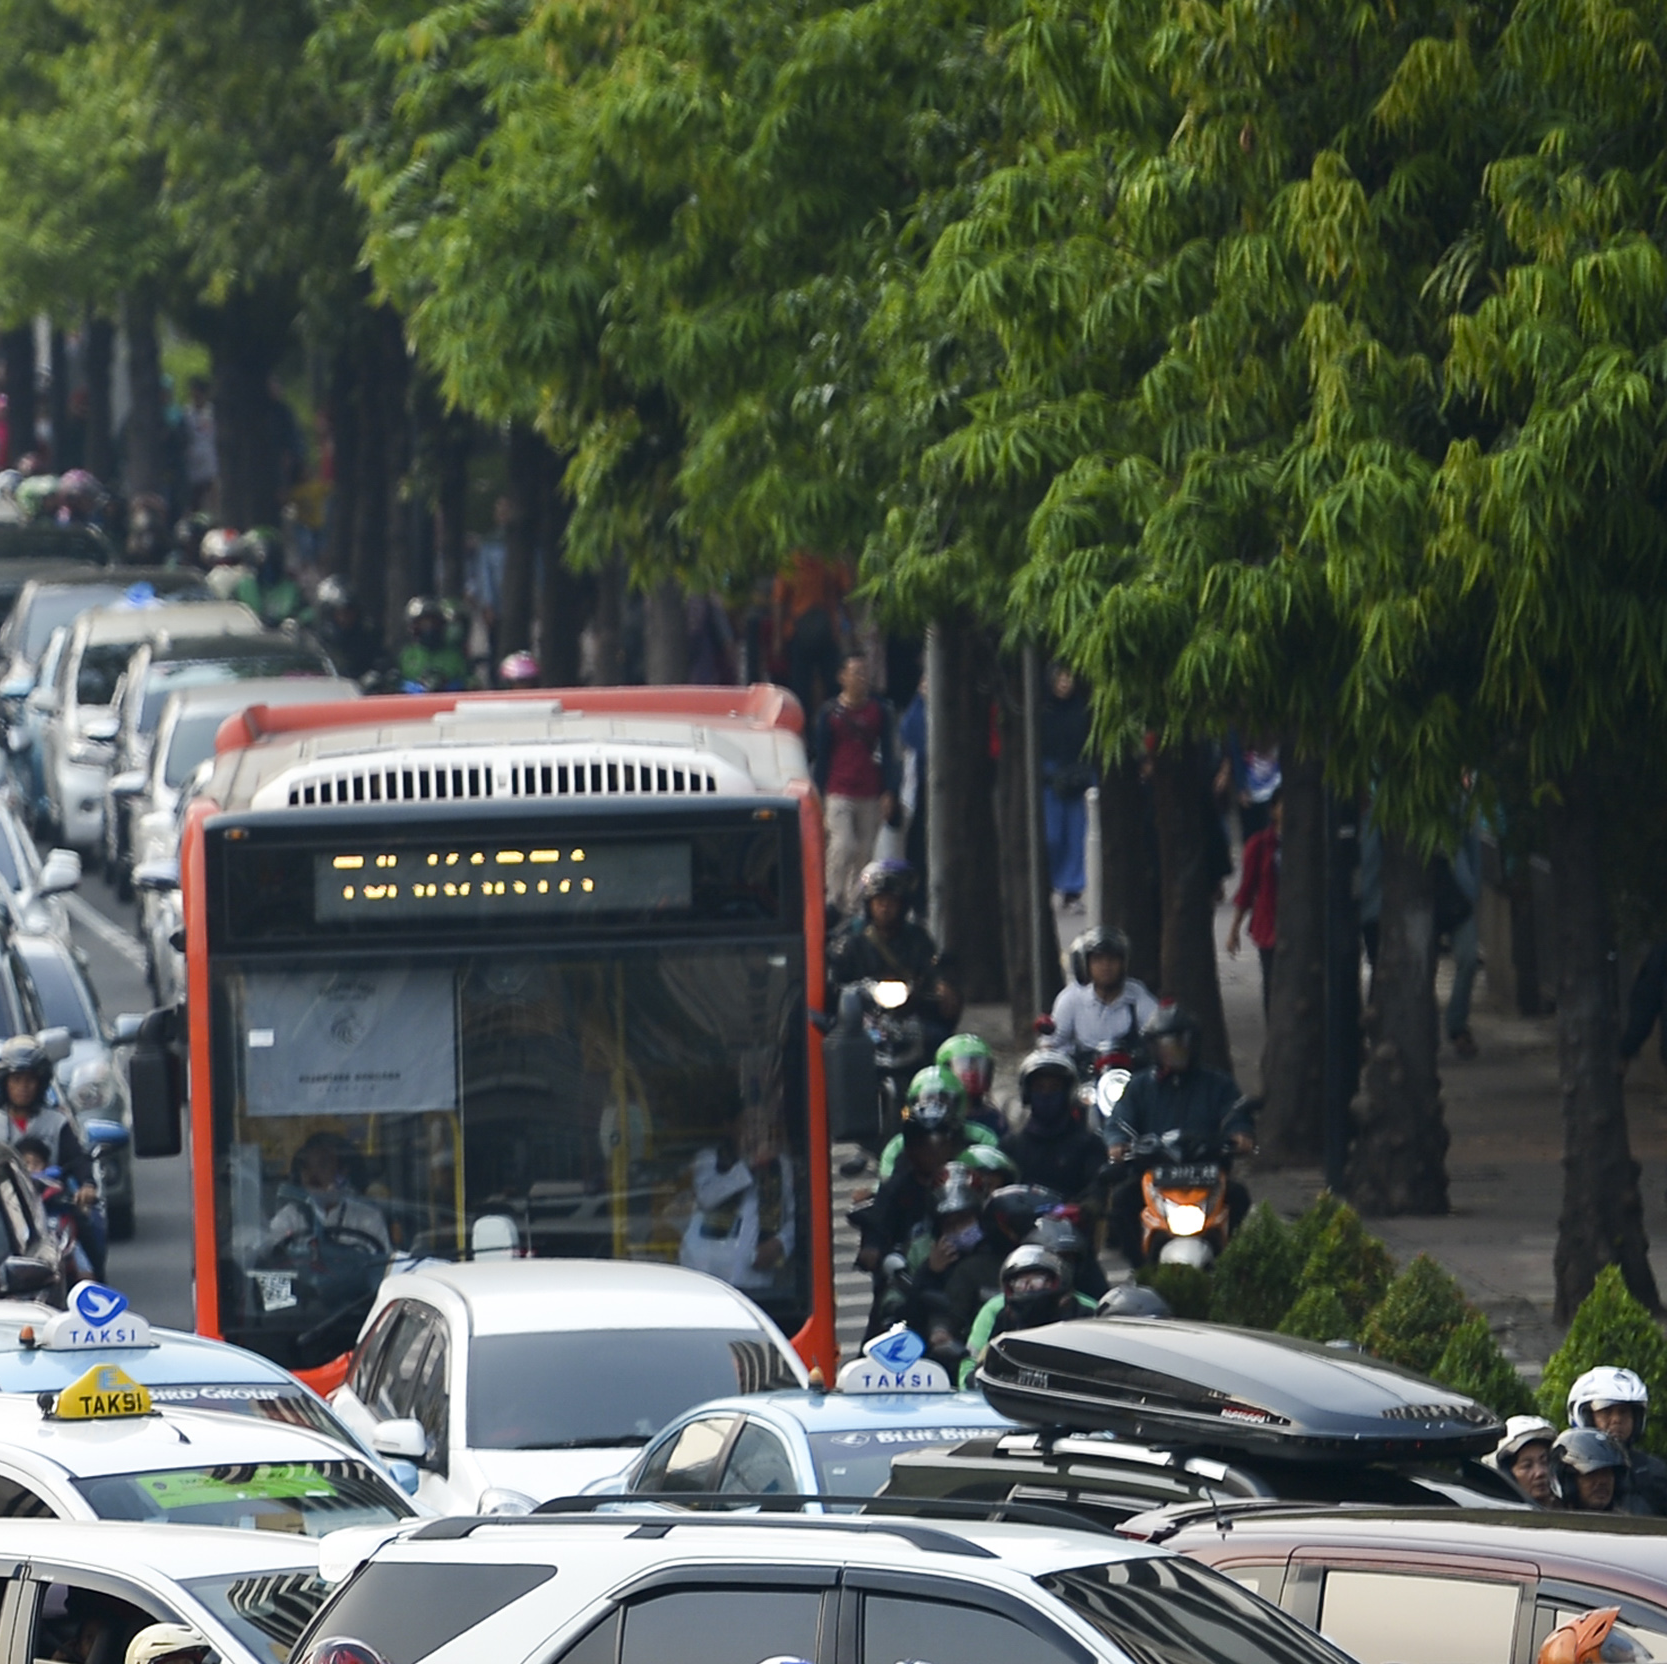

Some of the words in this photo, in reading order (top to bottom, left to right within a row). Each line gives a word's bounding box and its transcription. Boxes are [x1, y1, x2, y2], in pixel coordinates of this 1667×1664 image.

[70, 1328, 136, 1344] TAKSI
[862, 1373, 932, 1388] TAKSI
[80, 1393, 142, 1415] TAKSI
[876, 1430, 939, 1443] BLUE
